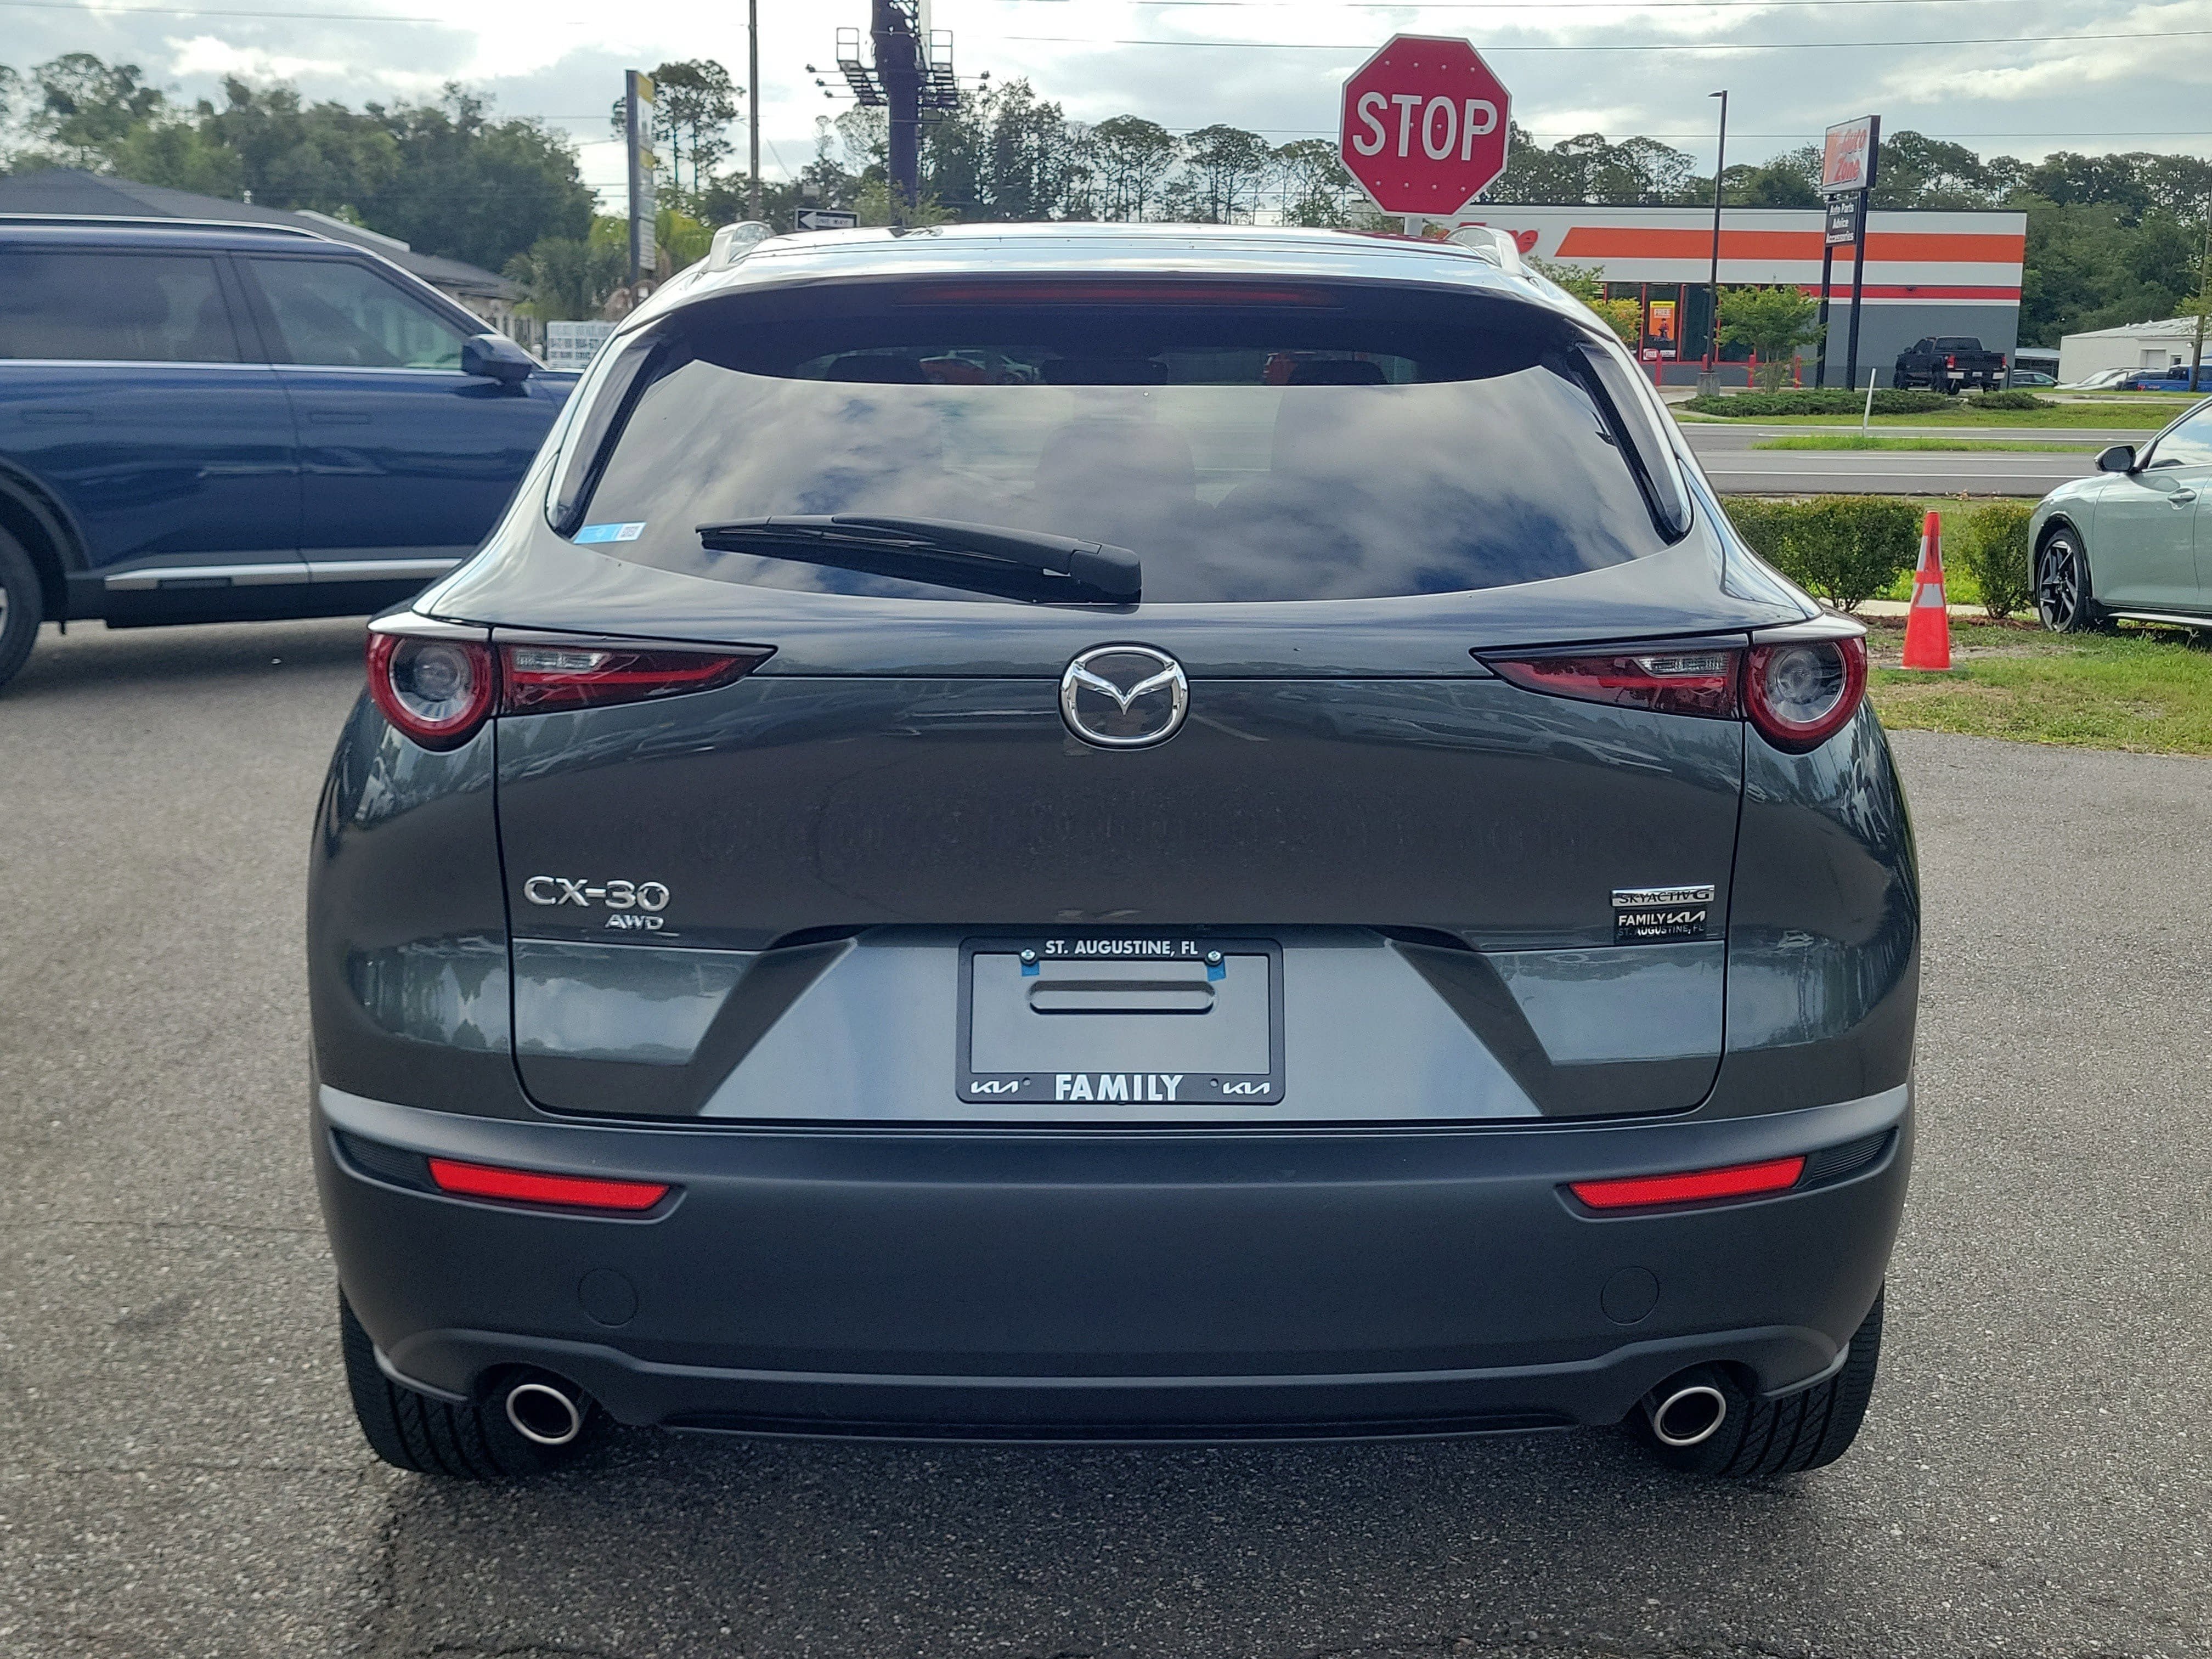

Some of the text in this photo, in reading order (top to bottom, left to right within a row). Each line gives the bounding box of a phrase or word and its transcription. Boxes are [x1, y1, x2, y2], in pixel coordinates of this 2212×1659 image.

[1352, 91, 1498, 161] STOP
[1840, 128, 1867, 155] Auto
[1834, 156, 1861, 184] Zone
[523, 876, 669, 912] CX-30
[605, 913, 664, 930] AWD
[1618, 913, 1666, 927] FAMILY
[1045, 940, 1198, 957] ST. AUGUSTINE, FL
[1054, 1074, 1184, 1101] FAMILY
